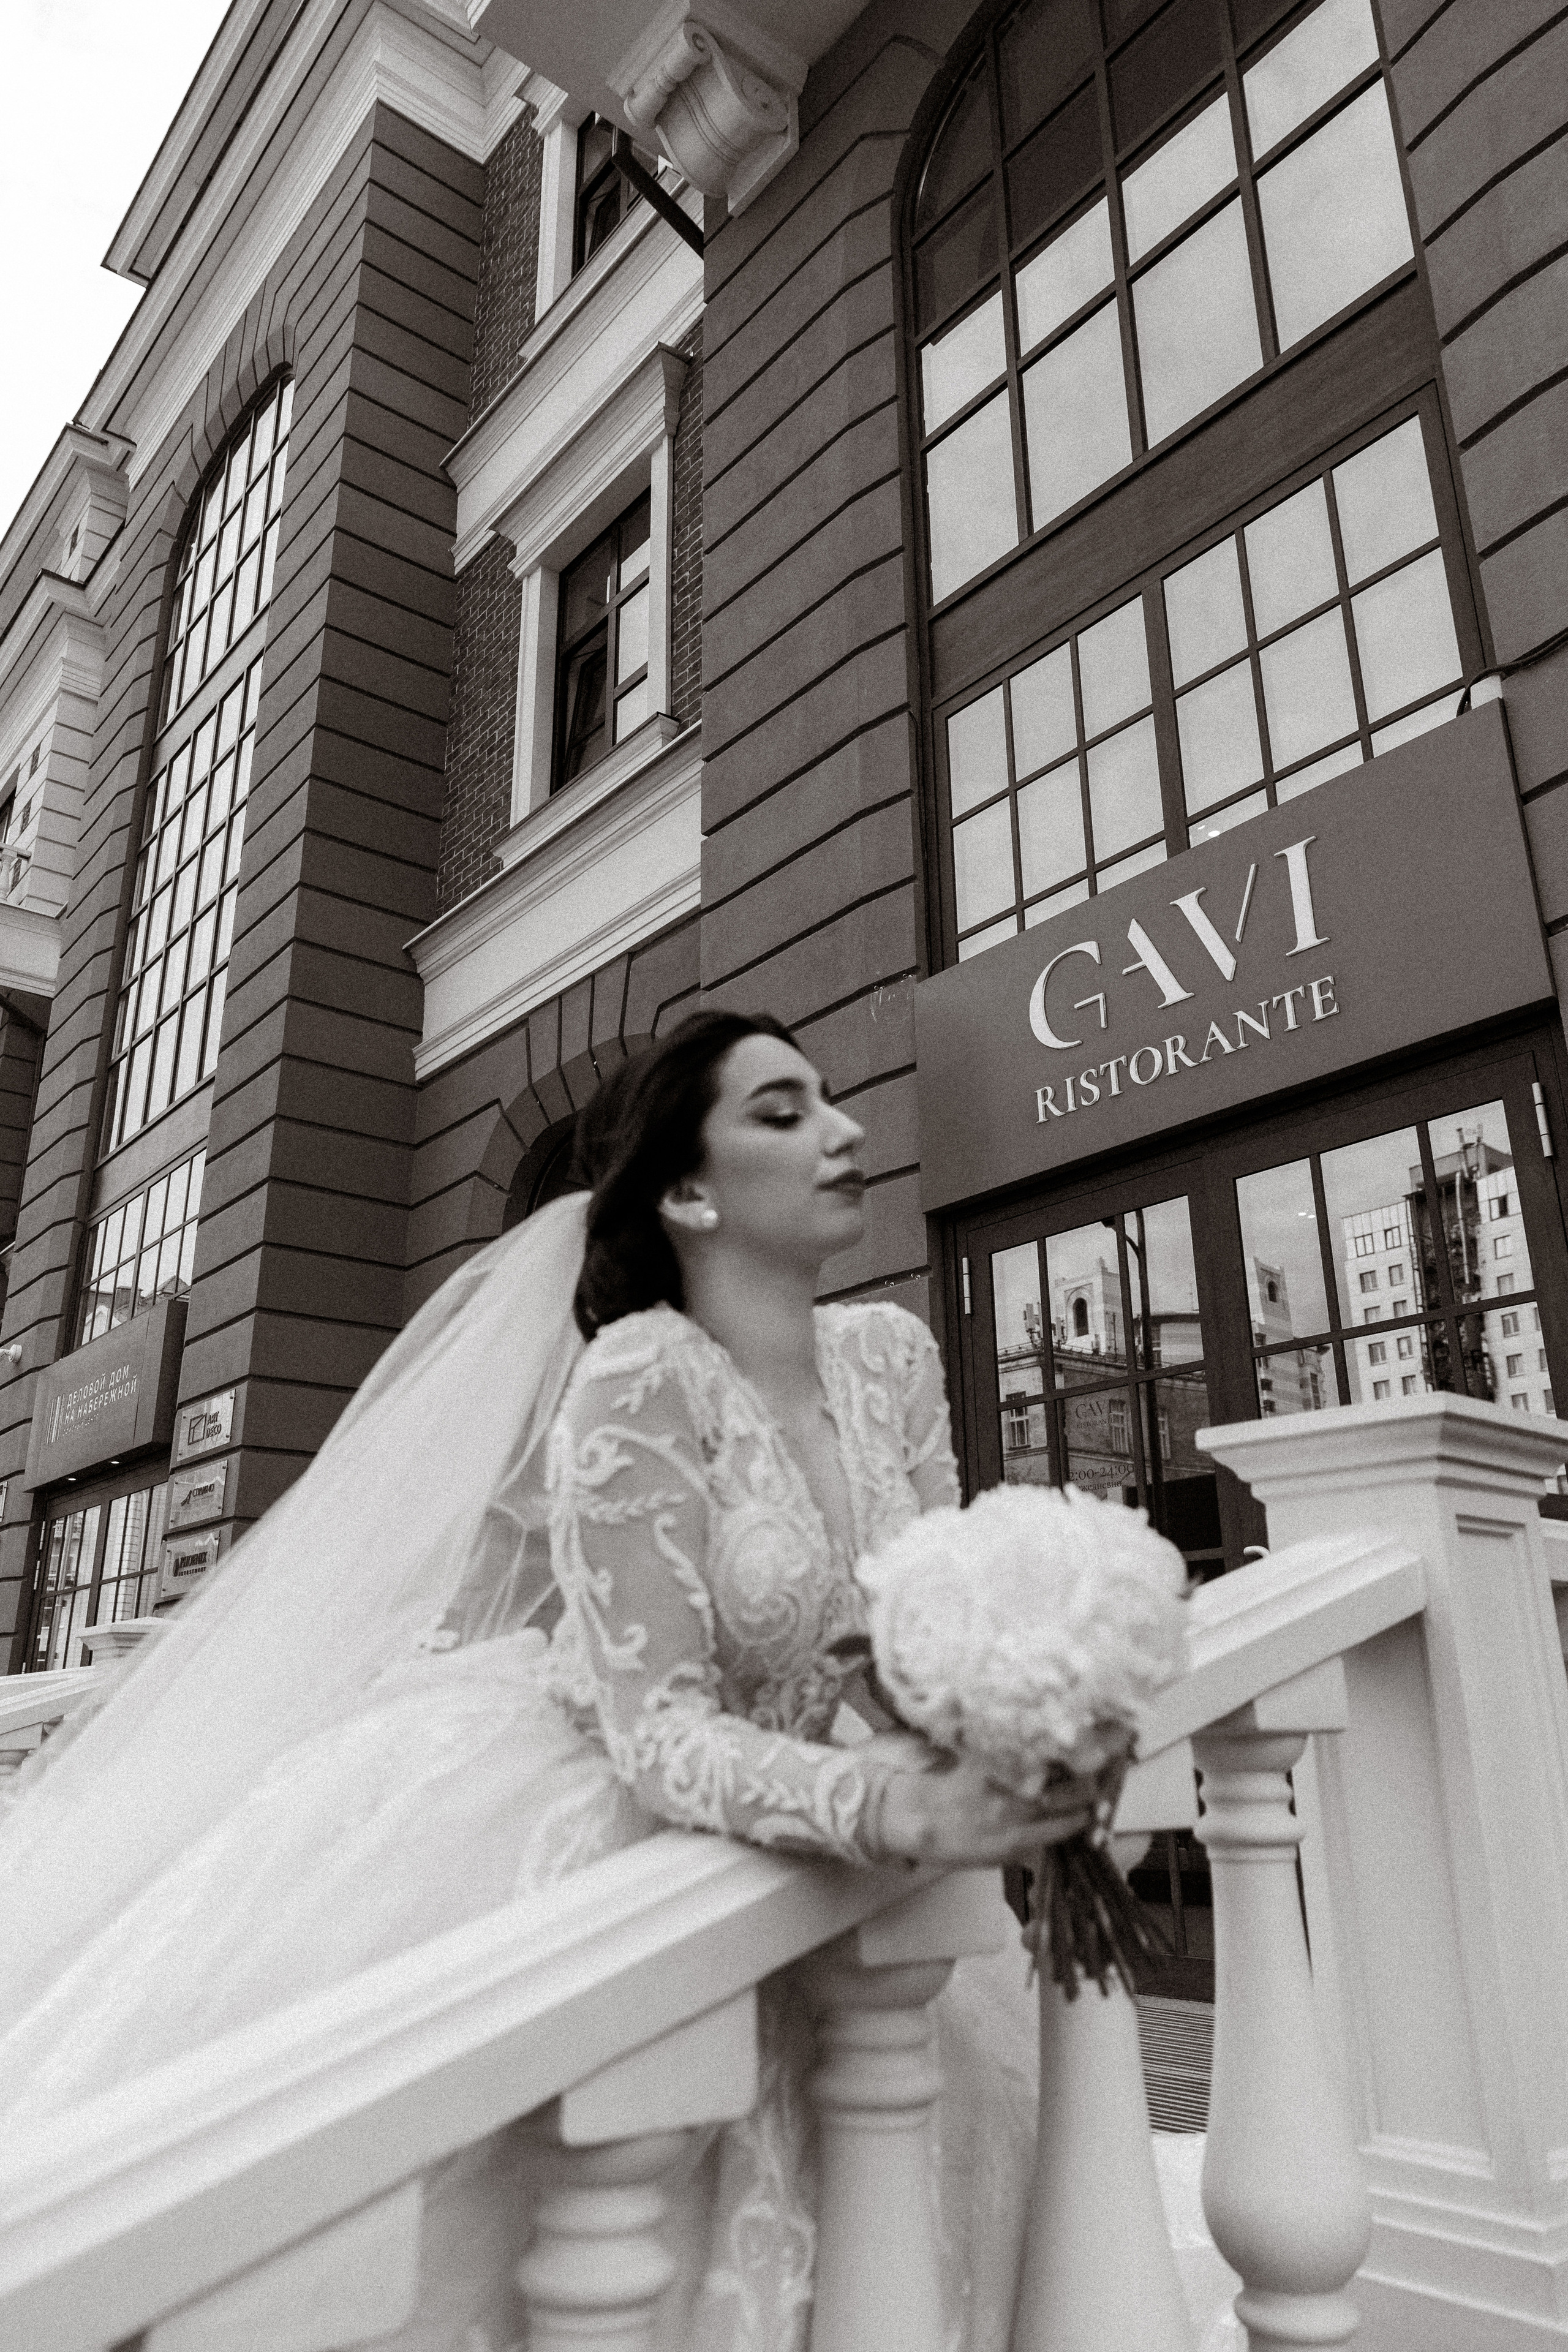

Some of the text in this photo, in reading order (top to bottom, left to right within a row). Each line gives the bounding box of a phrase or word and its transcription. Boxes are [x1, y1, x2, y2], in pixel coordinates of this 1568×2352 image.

[1029, 835, 1330, 1049] GAVI
[1035, 975, 1340, 1124] RISTORANTE
[66, 1364, 129, 1410] ДЕЛОВОЙ ДОМ
[64, 1374, 137, 1425] НА НАБЕРЕЖНОЙ
[1075, 1398, 1113, 1419] GAVI
[206, 1411, 220, 1426] ART
[205, 1423, 222, 1439] DECO
[1068, 1463, 1134, 1482] 2:00-24:00
[1079, 1480, 1122, 1492] жедневно
